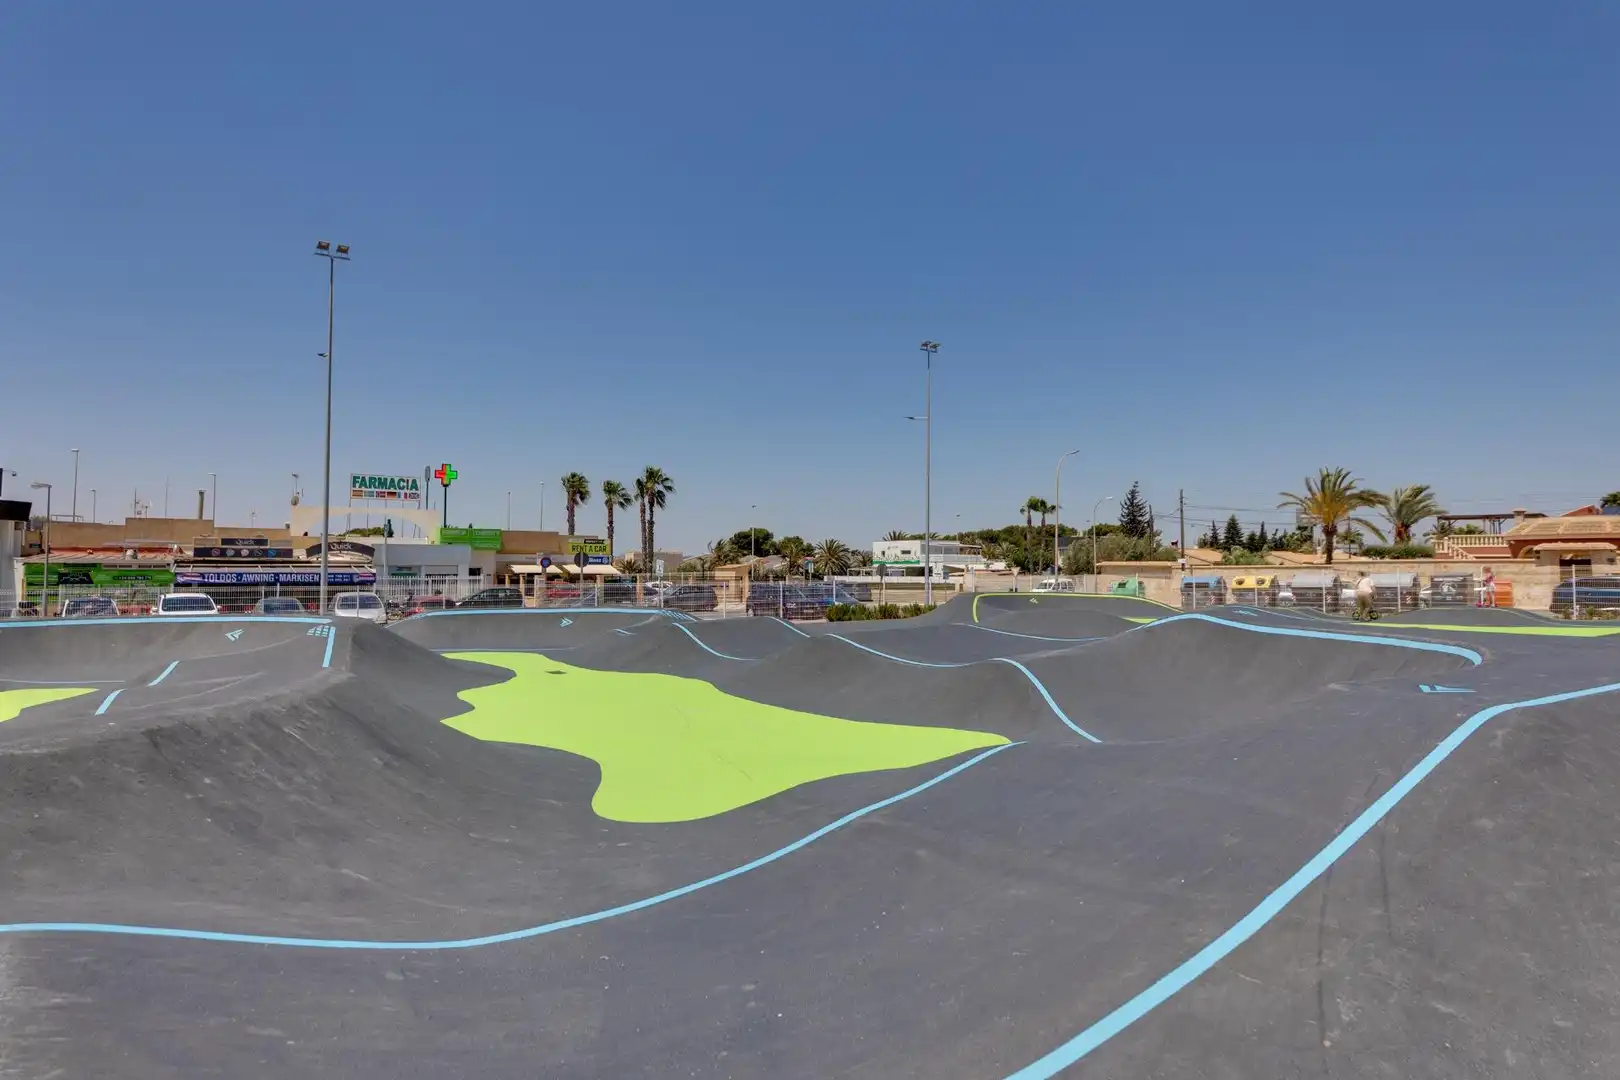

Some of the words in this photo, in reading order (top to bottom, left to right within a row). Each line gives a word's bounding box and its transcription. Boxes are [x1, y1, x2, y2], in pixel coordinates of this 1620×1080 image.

[352, 475, 419, 491] FARMACIA
[571, 545, 587, 553] RENT
[588, 545, 594, 553] A
[594, 545, 607, 553] CAR
[204, 573, 237, 583] TOLDOS
[242, 573, 275, 583] AWNING
[279, 573, 320, 583] MARKISEN
